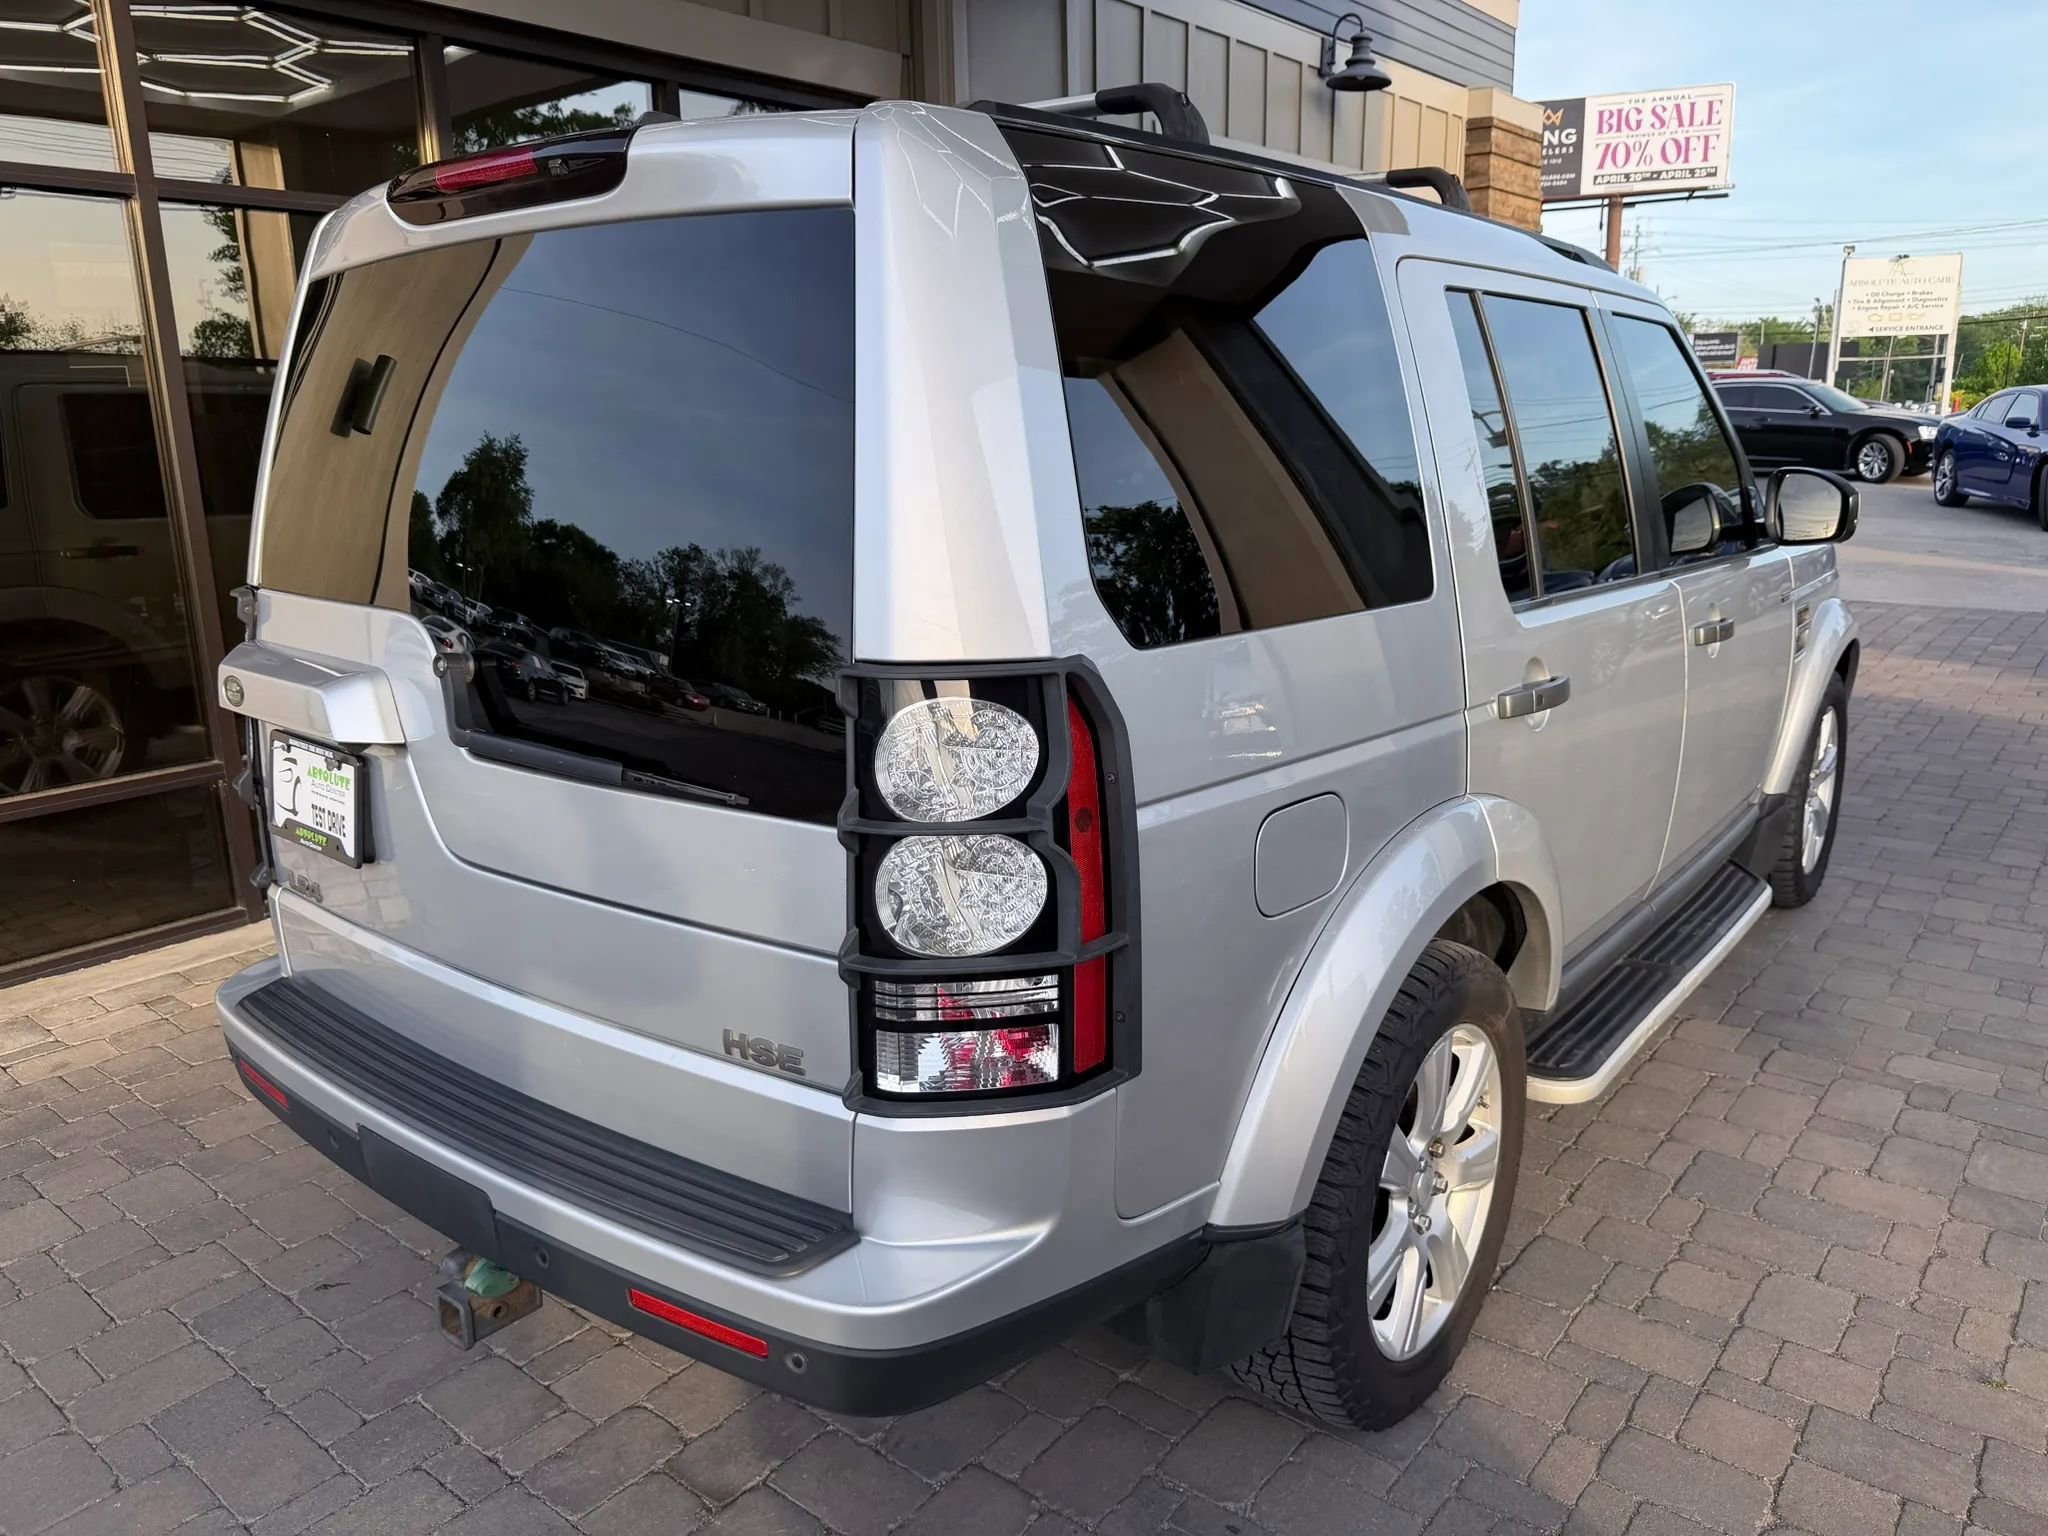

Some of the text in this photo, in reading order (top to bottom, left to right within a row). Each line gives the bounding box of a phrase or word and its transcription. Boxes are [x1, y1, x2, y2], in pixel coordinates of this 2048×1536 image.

[1628, 94, 1693, 105] THE ANNUAL
[1596, 100, 1723, 135] BIG SALE
[1595, 134, 1720, 170] 70% OFF
[1594, 174, 1628, 185] APRIL
[1659, 169, 1692, 180] APRIL
[1881, 291, 1905, 299] Change
[306, 764, 351, 791] ABSOLUTE
[311, 803, 347, 838] TEST DRIVE
[722, 1027, 806, 1076] HSE
